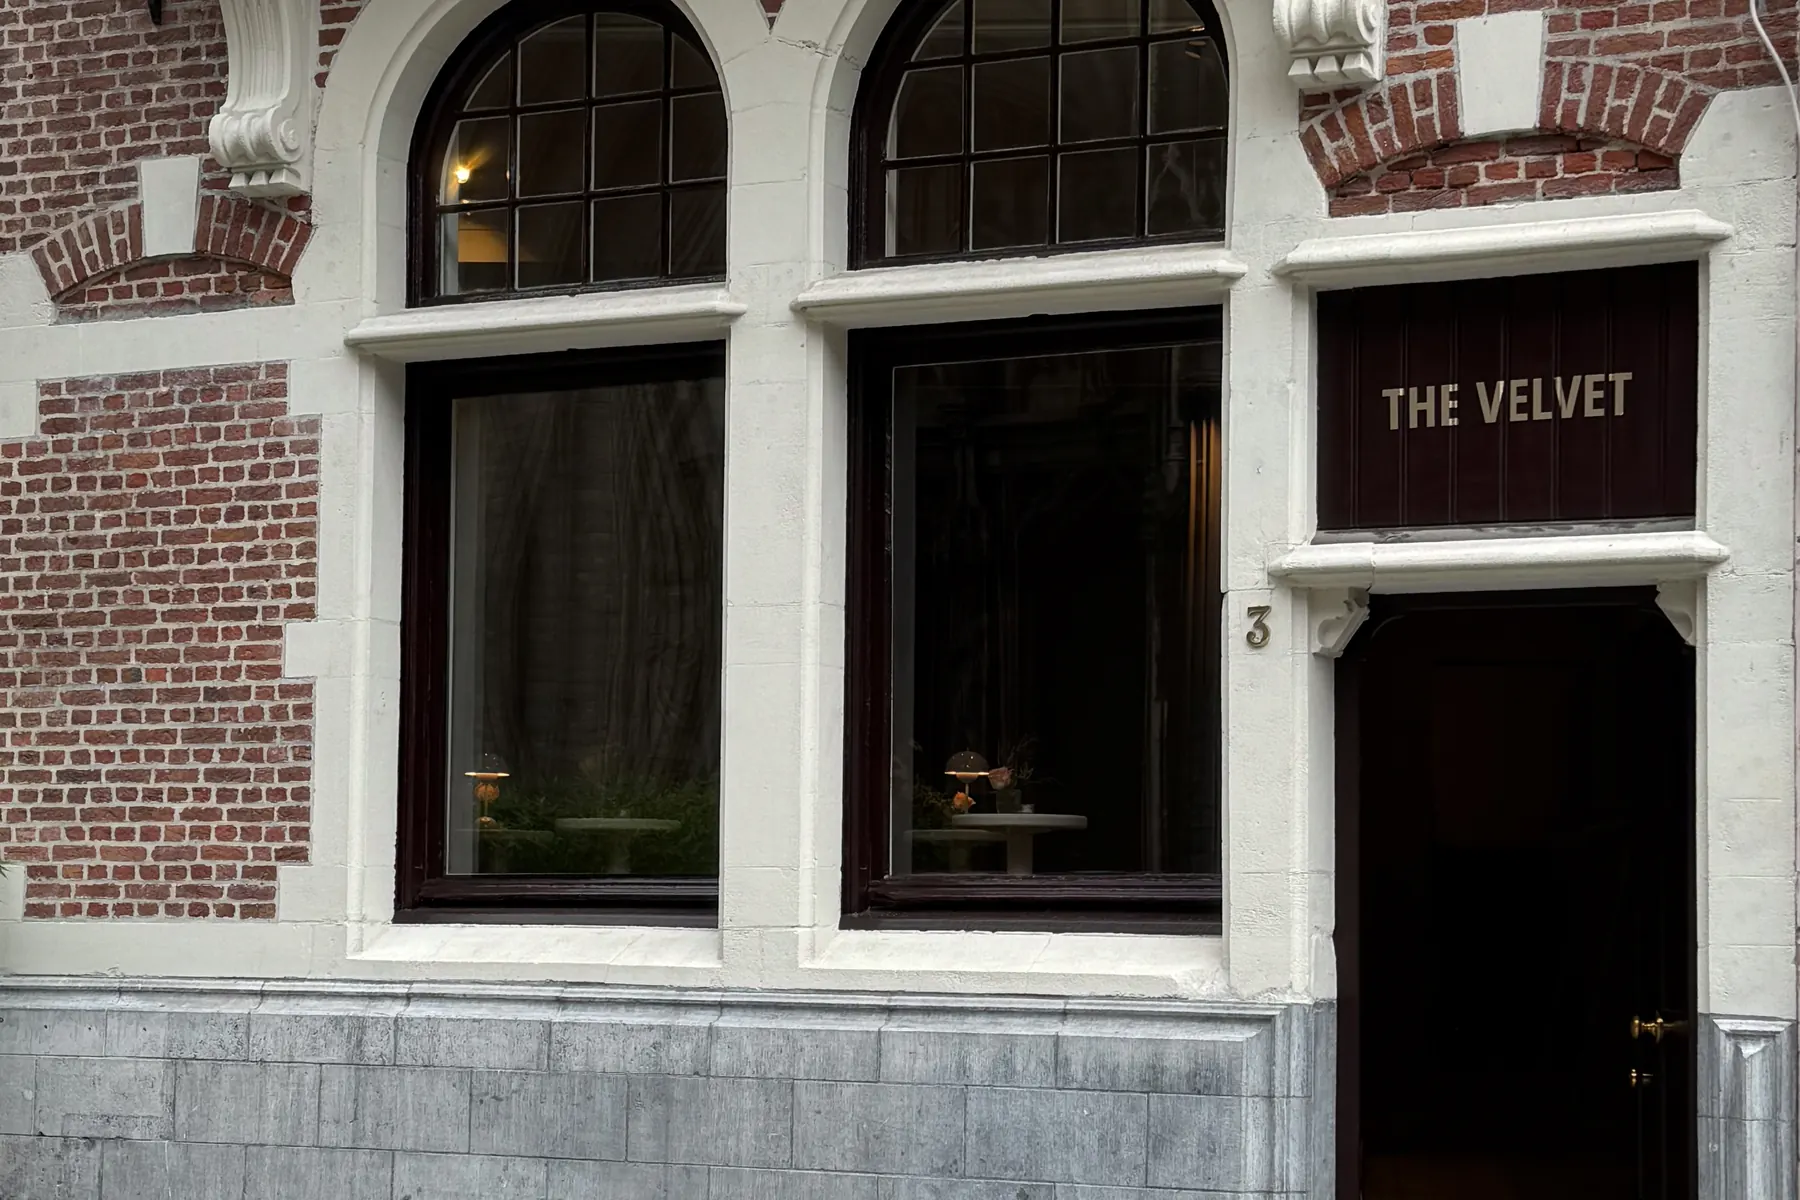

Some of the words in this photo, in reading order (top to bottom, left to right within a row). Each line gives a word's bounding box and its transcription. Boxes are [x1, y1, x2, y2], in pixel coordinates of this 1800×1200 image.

[1382, 384, 1459, 430] THE
[1476, 372, 1633, 424] VELVET
[1246, 606, 1272, 648] 3
